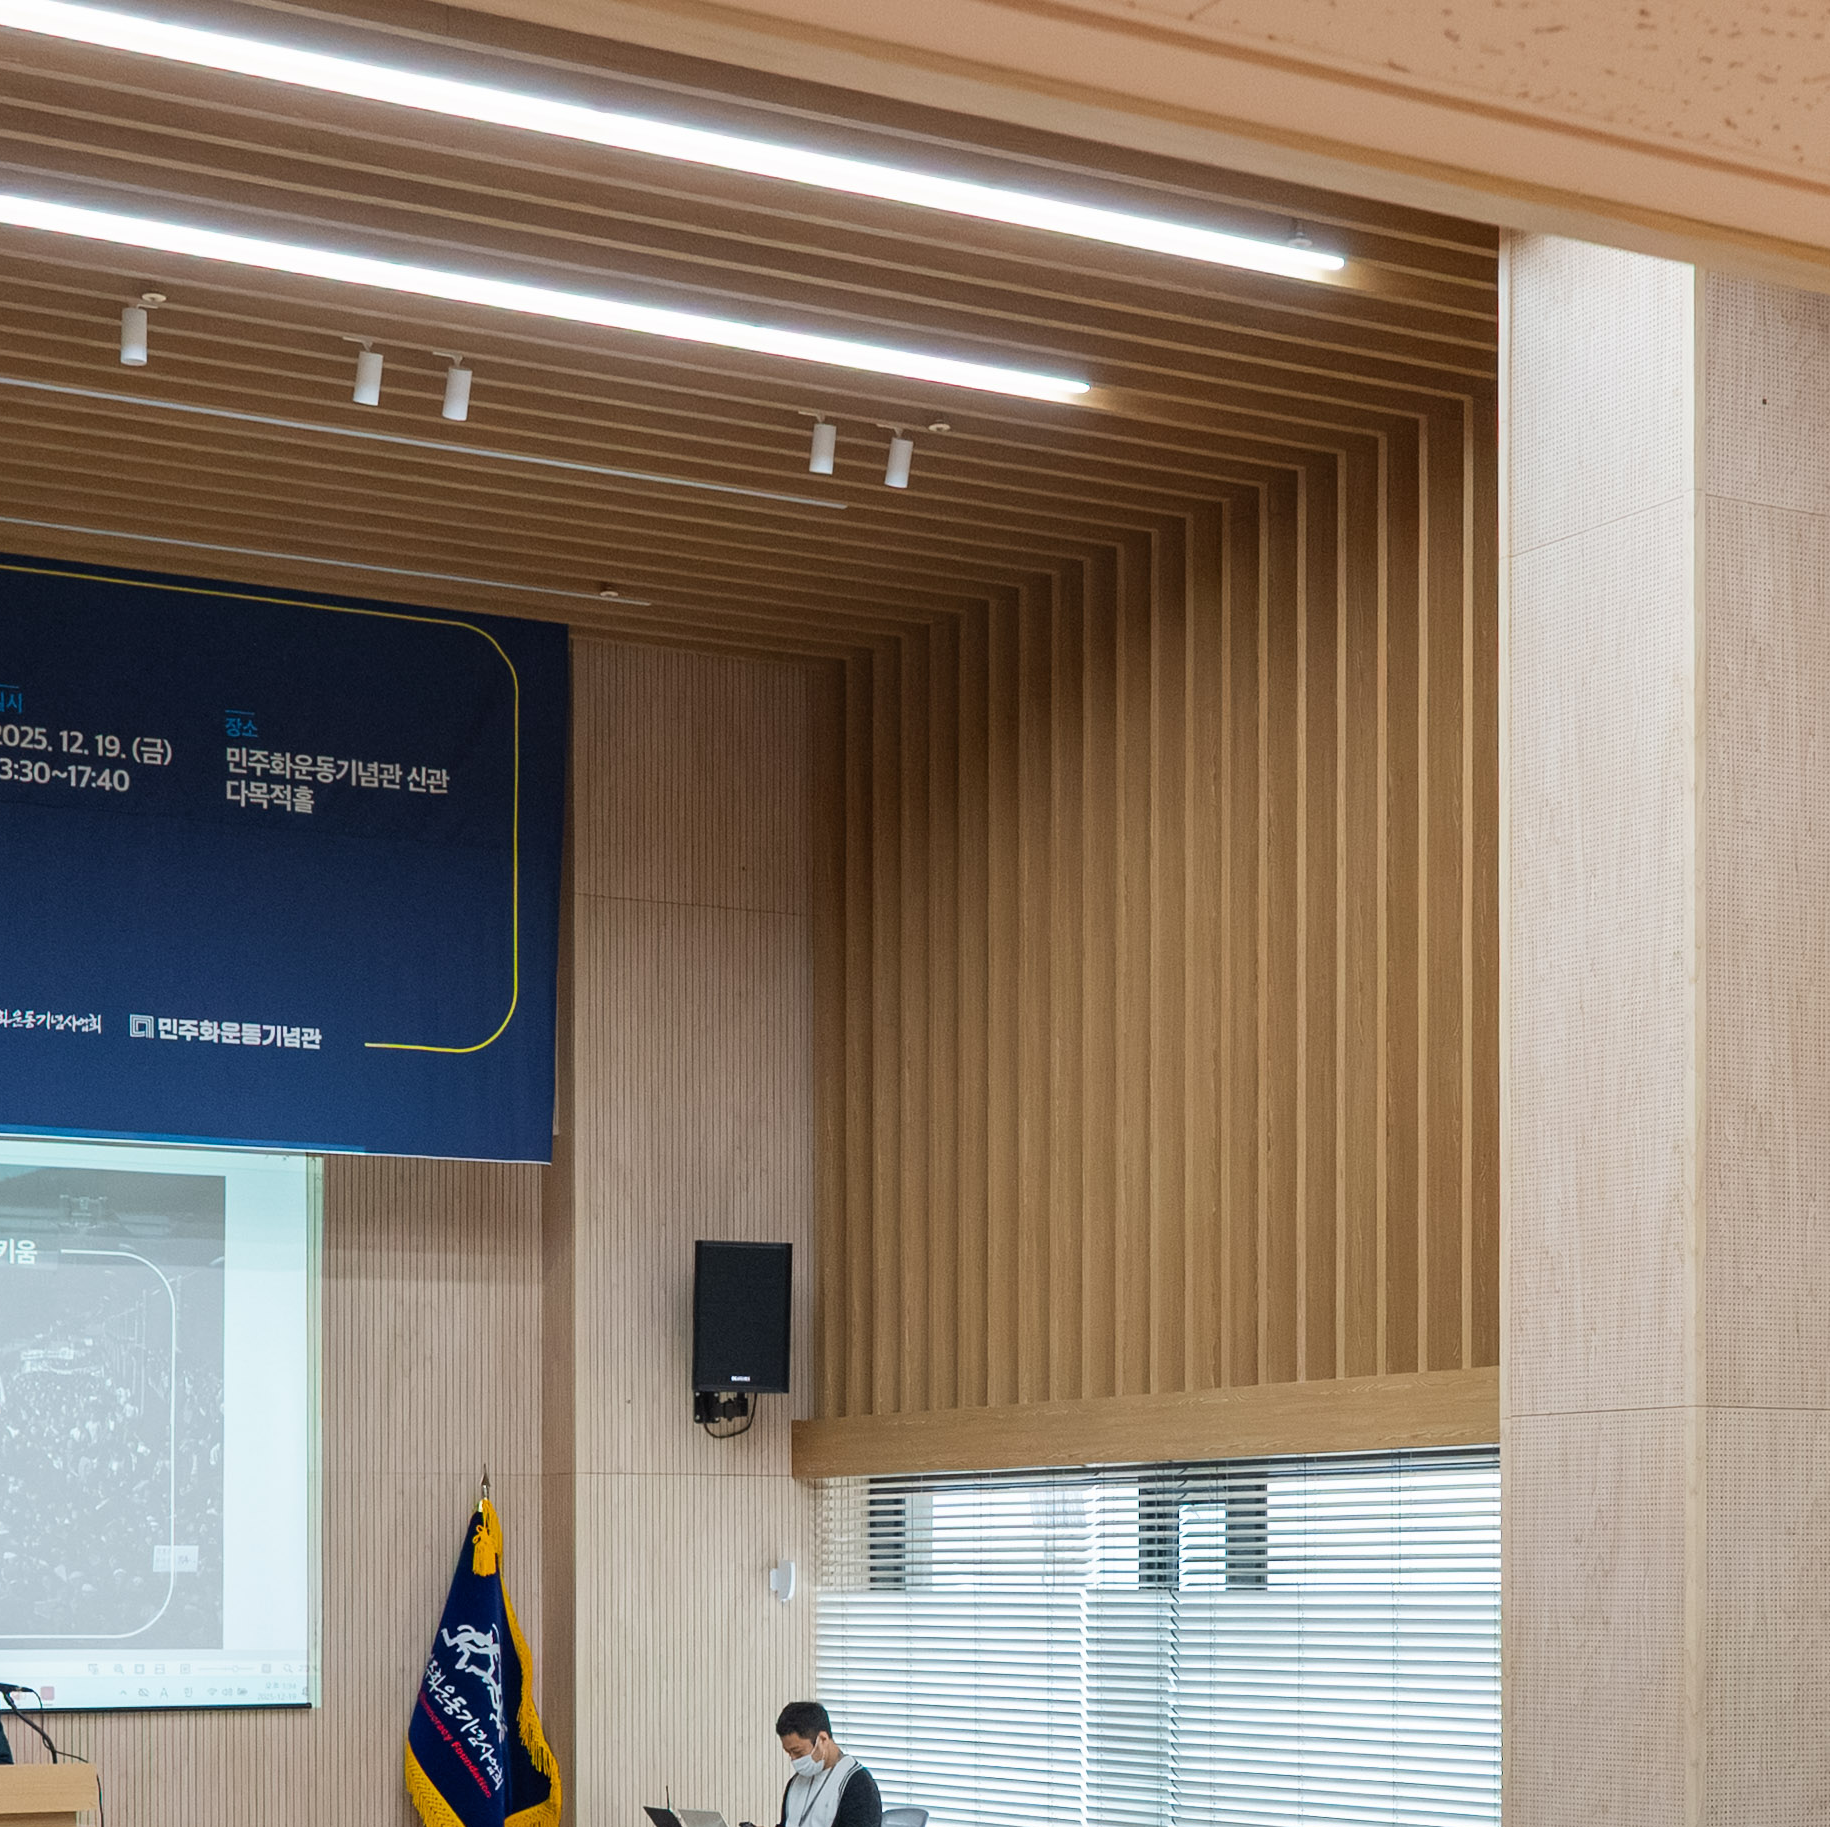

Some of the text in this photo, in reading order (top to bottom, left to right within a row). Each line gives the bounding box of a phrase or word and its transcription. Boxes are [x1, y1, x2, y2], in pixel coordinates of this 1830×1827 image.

[224, 715, 259, 739] 장소
[59, 730, 90, 755] 12.
[95, 734, 126, 760] 19.
[132, 736, 173, 766] (금)
[225, 746, 450, 796] 민주화운동기념관 신관
[225, 779, 315, 815] 다목적홀
[157, 1017, 322, 1051] 민주화운동기념관
[450, 1740, 494, 1800] Foundation
